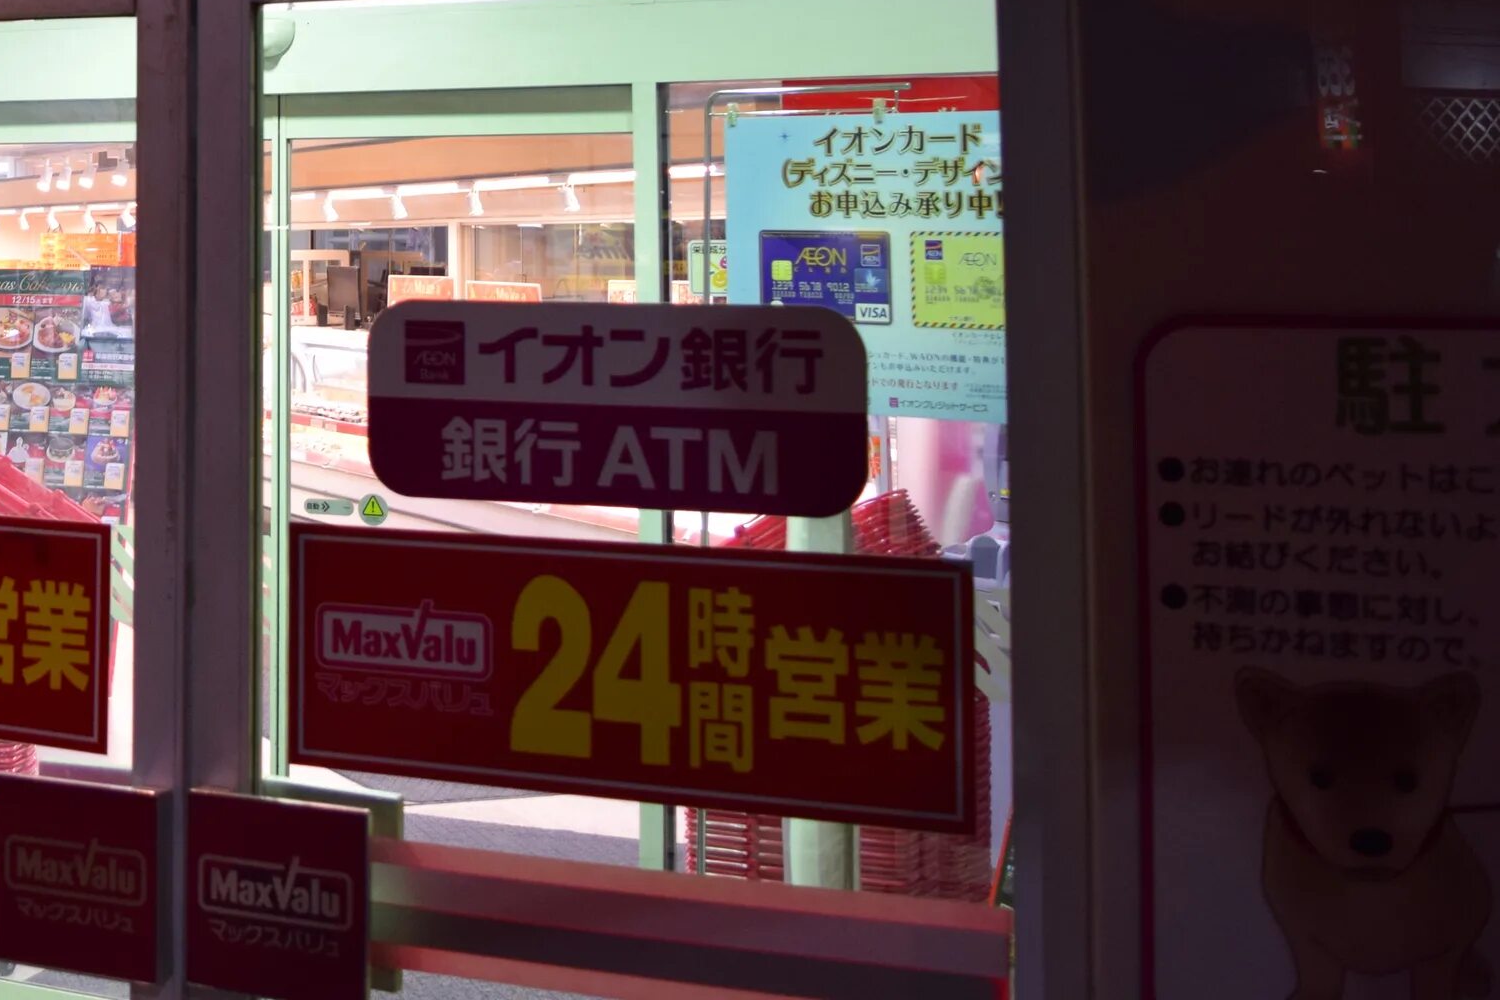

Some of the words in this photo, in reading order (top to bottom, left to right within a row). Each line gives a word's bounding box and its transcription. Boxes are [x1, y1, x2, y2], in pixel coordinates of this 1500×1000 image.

[813, 122, 984, 157] イオンカード
[859, 306, 888, 319] VISA
[478, 324, 824, 395] イオン銀行
[440, 416, 582, 488] 銀行
[596, 424, 779, 496] ATM
[332, 602, 477, 666] MaxValu
[313, 671, 495, 717] マックスバリュ
[509, 573, 948, 773] 24時間営業
[15, 837, 136, 895] MaxValu
[208, 856, 342, 919] MaxValu
[16, 897, 135, 934] マックスバリュ
[207, 916, 341, 958] マックスバリュ
